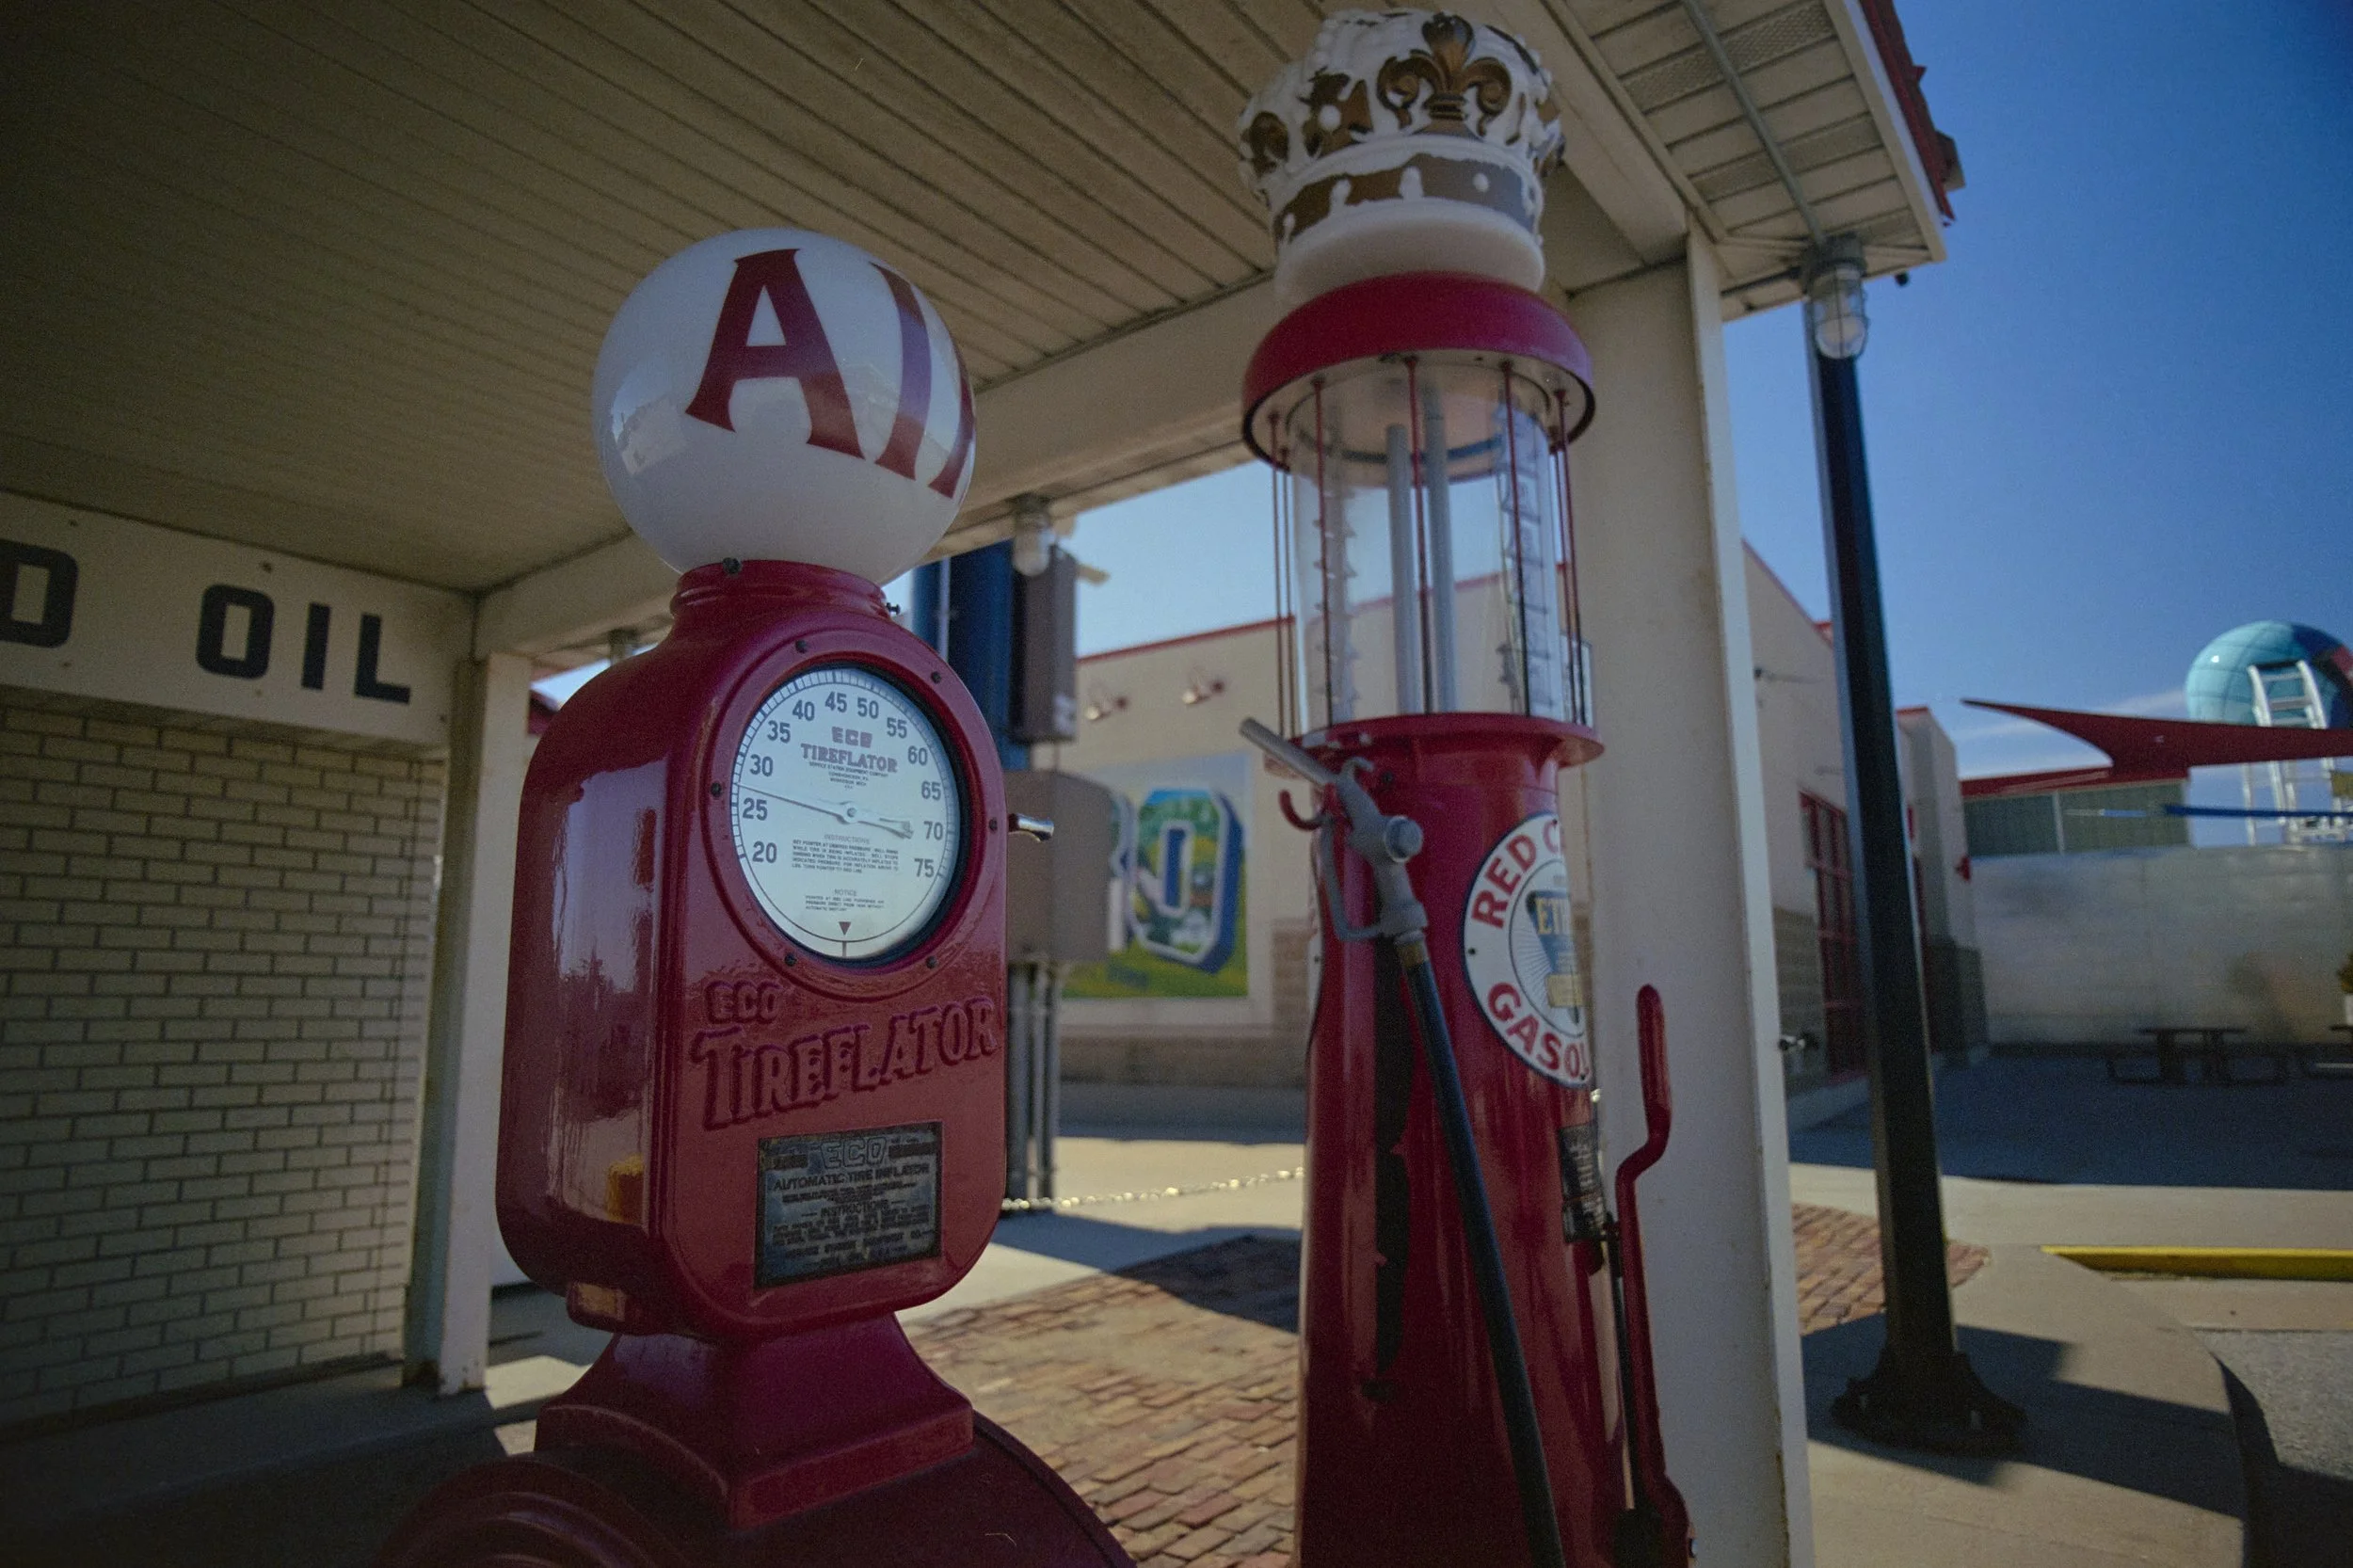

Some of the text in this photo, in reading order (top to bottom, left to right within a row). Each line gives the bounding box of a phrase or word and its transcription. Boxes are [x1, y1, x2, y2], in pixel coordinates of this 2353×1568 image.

[196, 584, 411, 704] OIL
[792, 700, 815, 721] 40
[824, 691, 847, 712] 45
[856, 697, 879, 719] 50
[767, 720, 791, 744] 35
[887, 717, 908, 739] 55
[749, 755, 774, 777] 30
[800, 743, 898, 774] TIREFLATOR
[907, 745, 928, 766] 60
[921, 781, 941, 800] 65
[743, 797, 768, 821] 25
[923, 821, 942, 840] 70
[752, 841, 776, 863] 20
[914, 858, 935, 878] 75
[1471, 834, 1537, 929] RED
[707, 981, 782, 1024] ECO
[690, 996, 999, 1130] TIREFLATOR
[820, 1136, 888, 1169] ECO
[774, 1173, 846, 1191] AUTOMATIC
